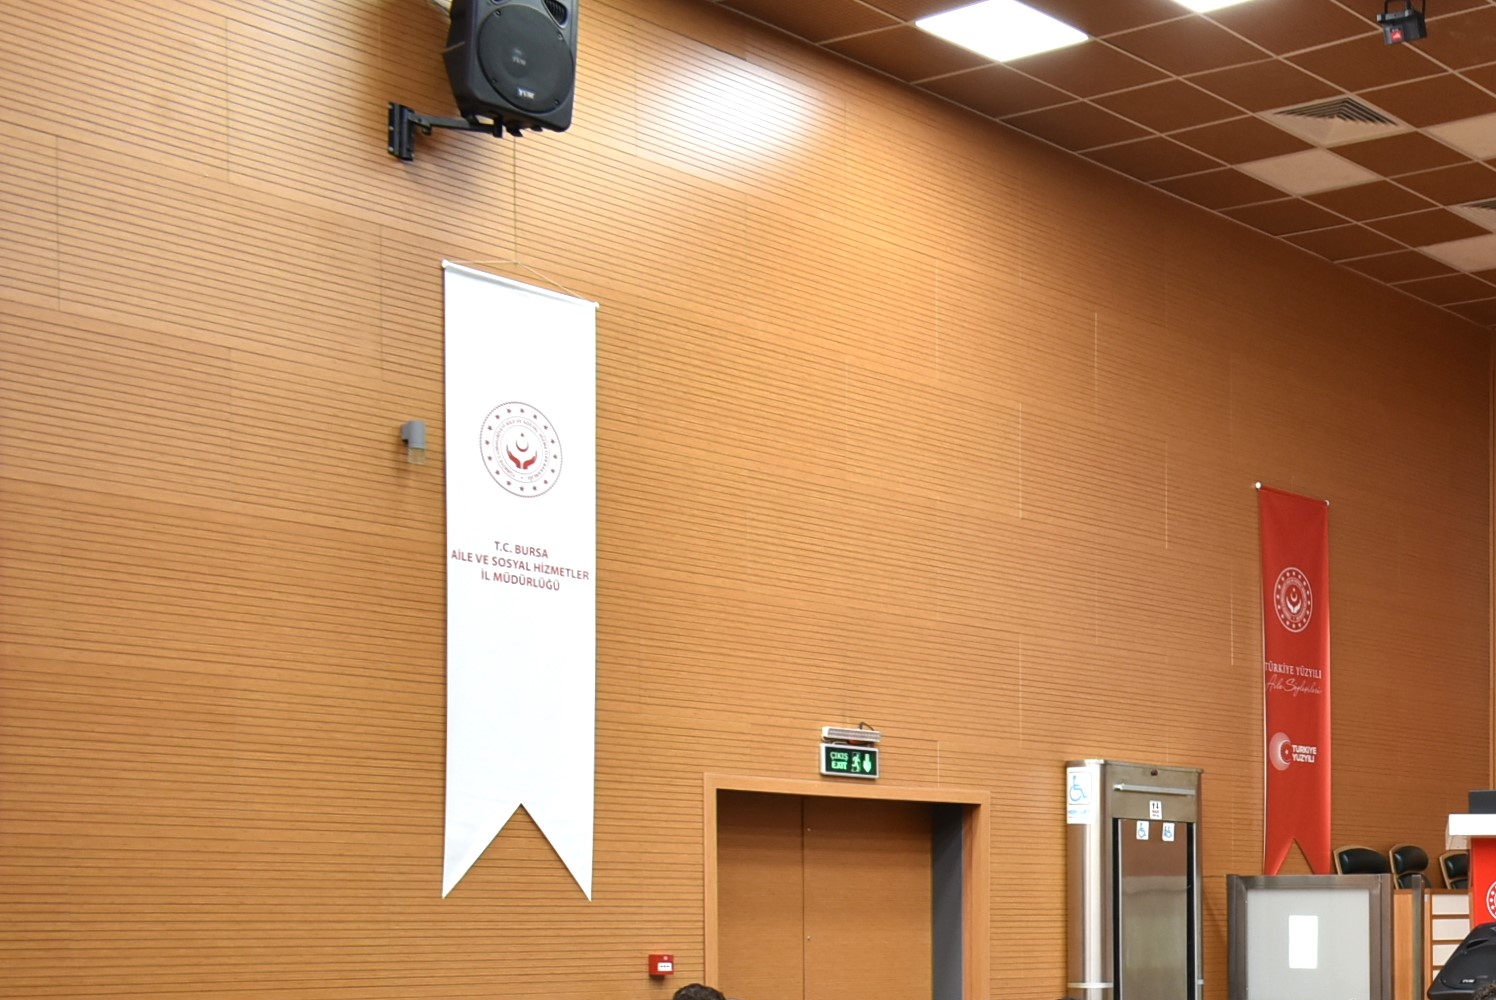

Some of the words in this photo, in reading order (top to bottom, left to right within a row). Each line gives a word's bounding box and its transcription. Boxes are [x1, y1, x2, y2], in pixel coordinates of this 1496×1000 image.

[494, 541, 513, 554] T.C.
[515, 544, 549, 559] BURSA
[451, 549, 473, 563] AİLE
[475, 553, 489, 566] VE
[492, 556, 531, 572] SOSYAL
[534, 562, 590, 580] HİZMETLER
[481, 570, 491, 581] İL
[493, 571, 560, 591] MÜDÜRLÜĞÜ
[1265, 660, 1294, 675] TÜRKİYE
[1296, 665, 1322, 679] YÜZYILI
[831, 760, 848, 770] EXIT
